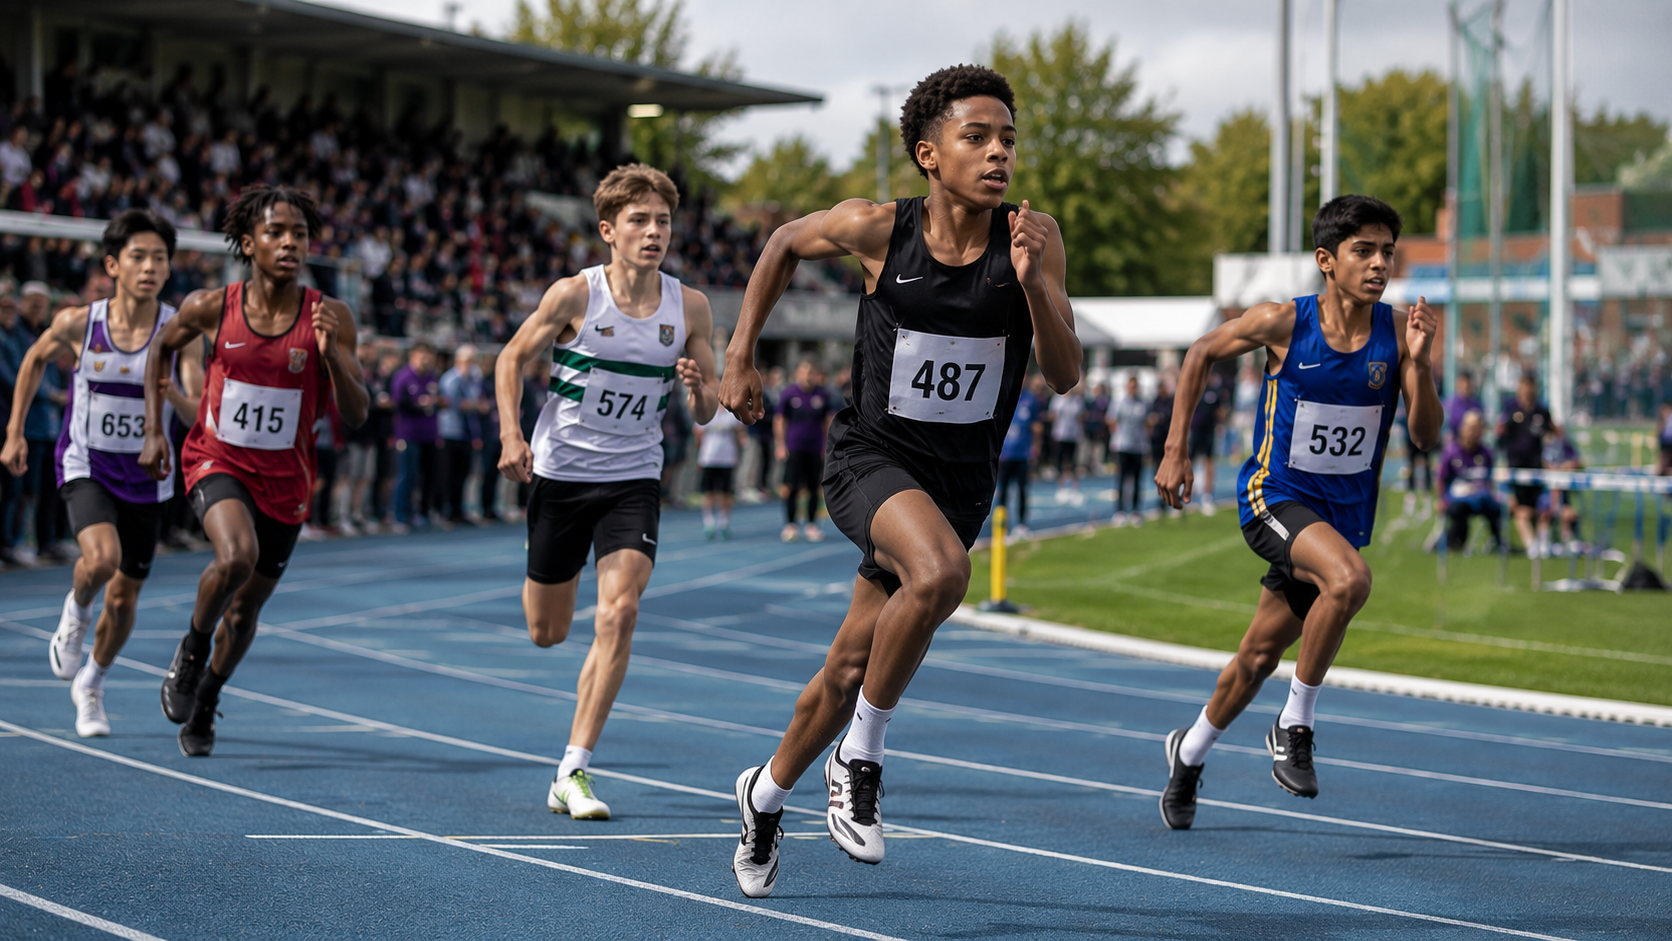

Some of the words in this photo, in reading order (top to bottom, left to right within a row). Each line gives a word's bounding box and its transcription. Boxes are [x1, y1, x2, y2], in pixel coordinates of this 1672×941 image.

[911, 360, 987, 402] 487
[233, 403, 285, 434] 415
[596, 388, 649, 422] 574
[102, 413, 145, 438] 653
[1309, 424, 1366, 457] 532
